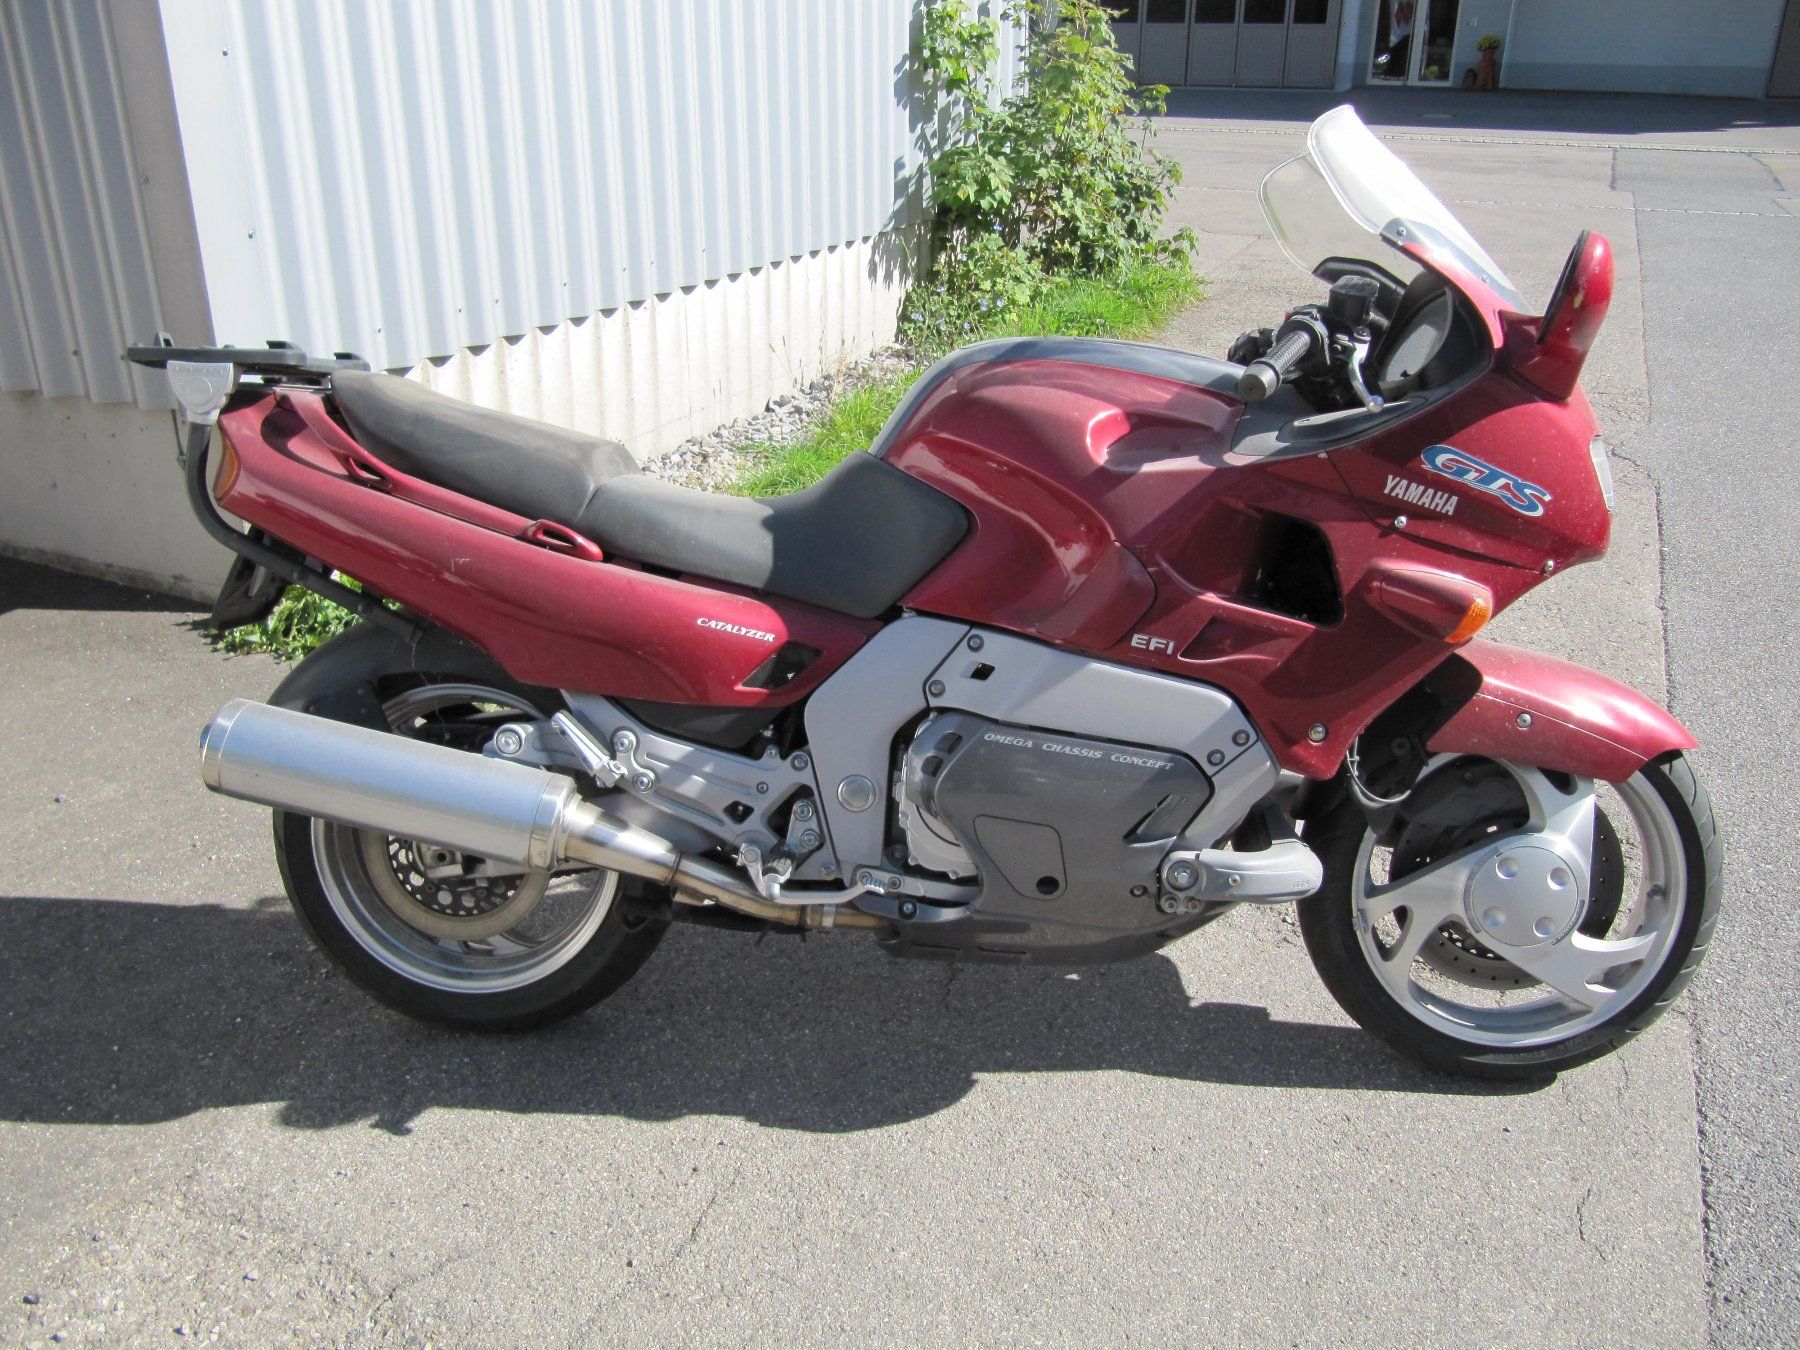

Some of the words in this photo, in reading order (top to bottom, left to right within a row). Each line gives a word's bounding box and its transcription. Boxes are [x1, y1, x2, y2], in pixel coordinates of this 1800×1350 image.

[1383, 474, 1459, 515] YAMAHA
[1420, 444, 1552, 516] GTS
[696, 617, 776, 642] CATALYZER
[1131, 633, 1174, 655] EFI
[984, 732, 1033, 748] OMEGA
[1042, 743, 1103, 759] CHASSIS
[1111, 753, 1174, 770] CONCEPT
